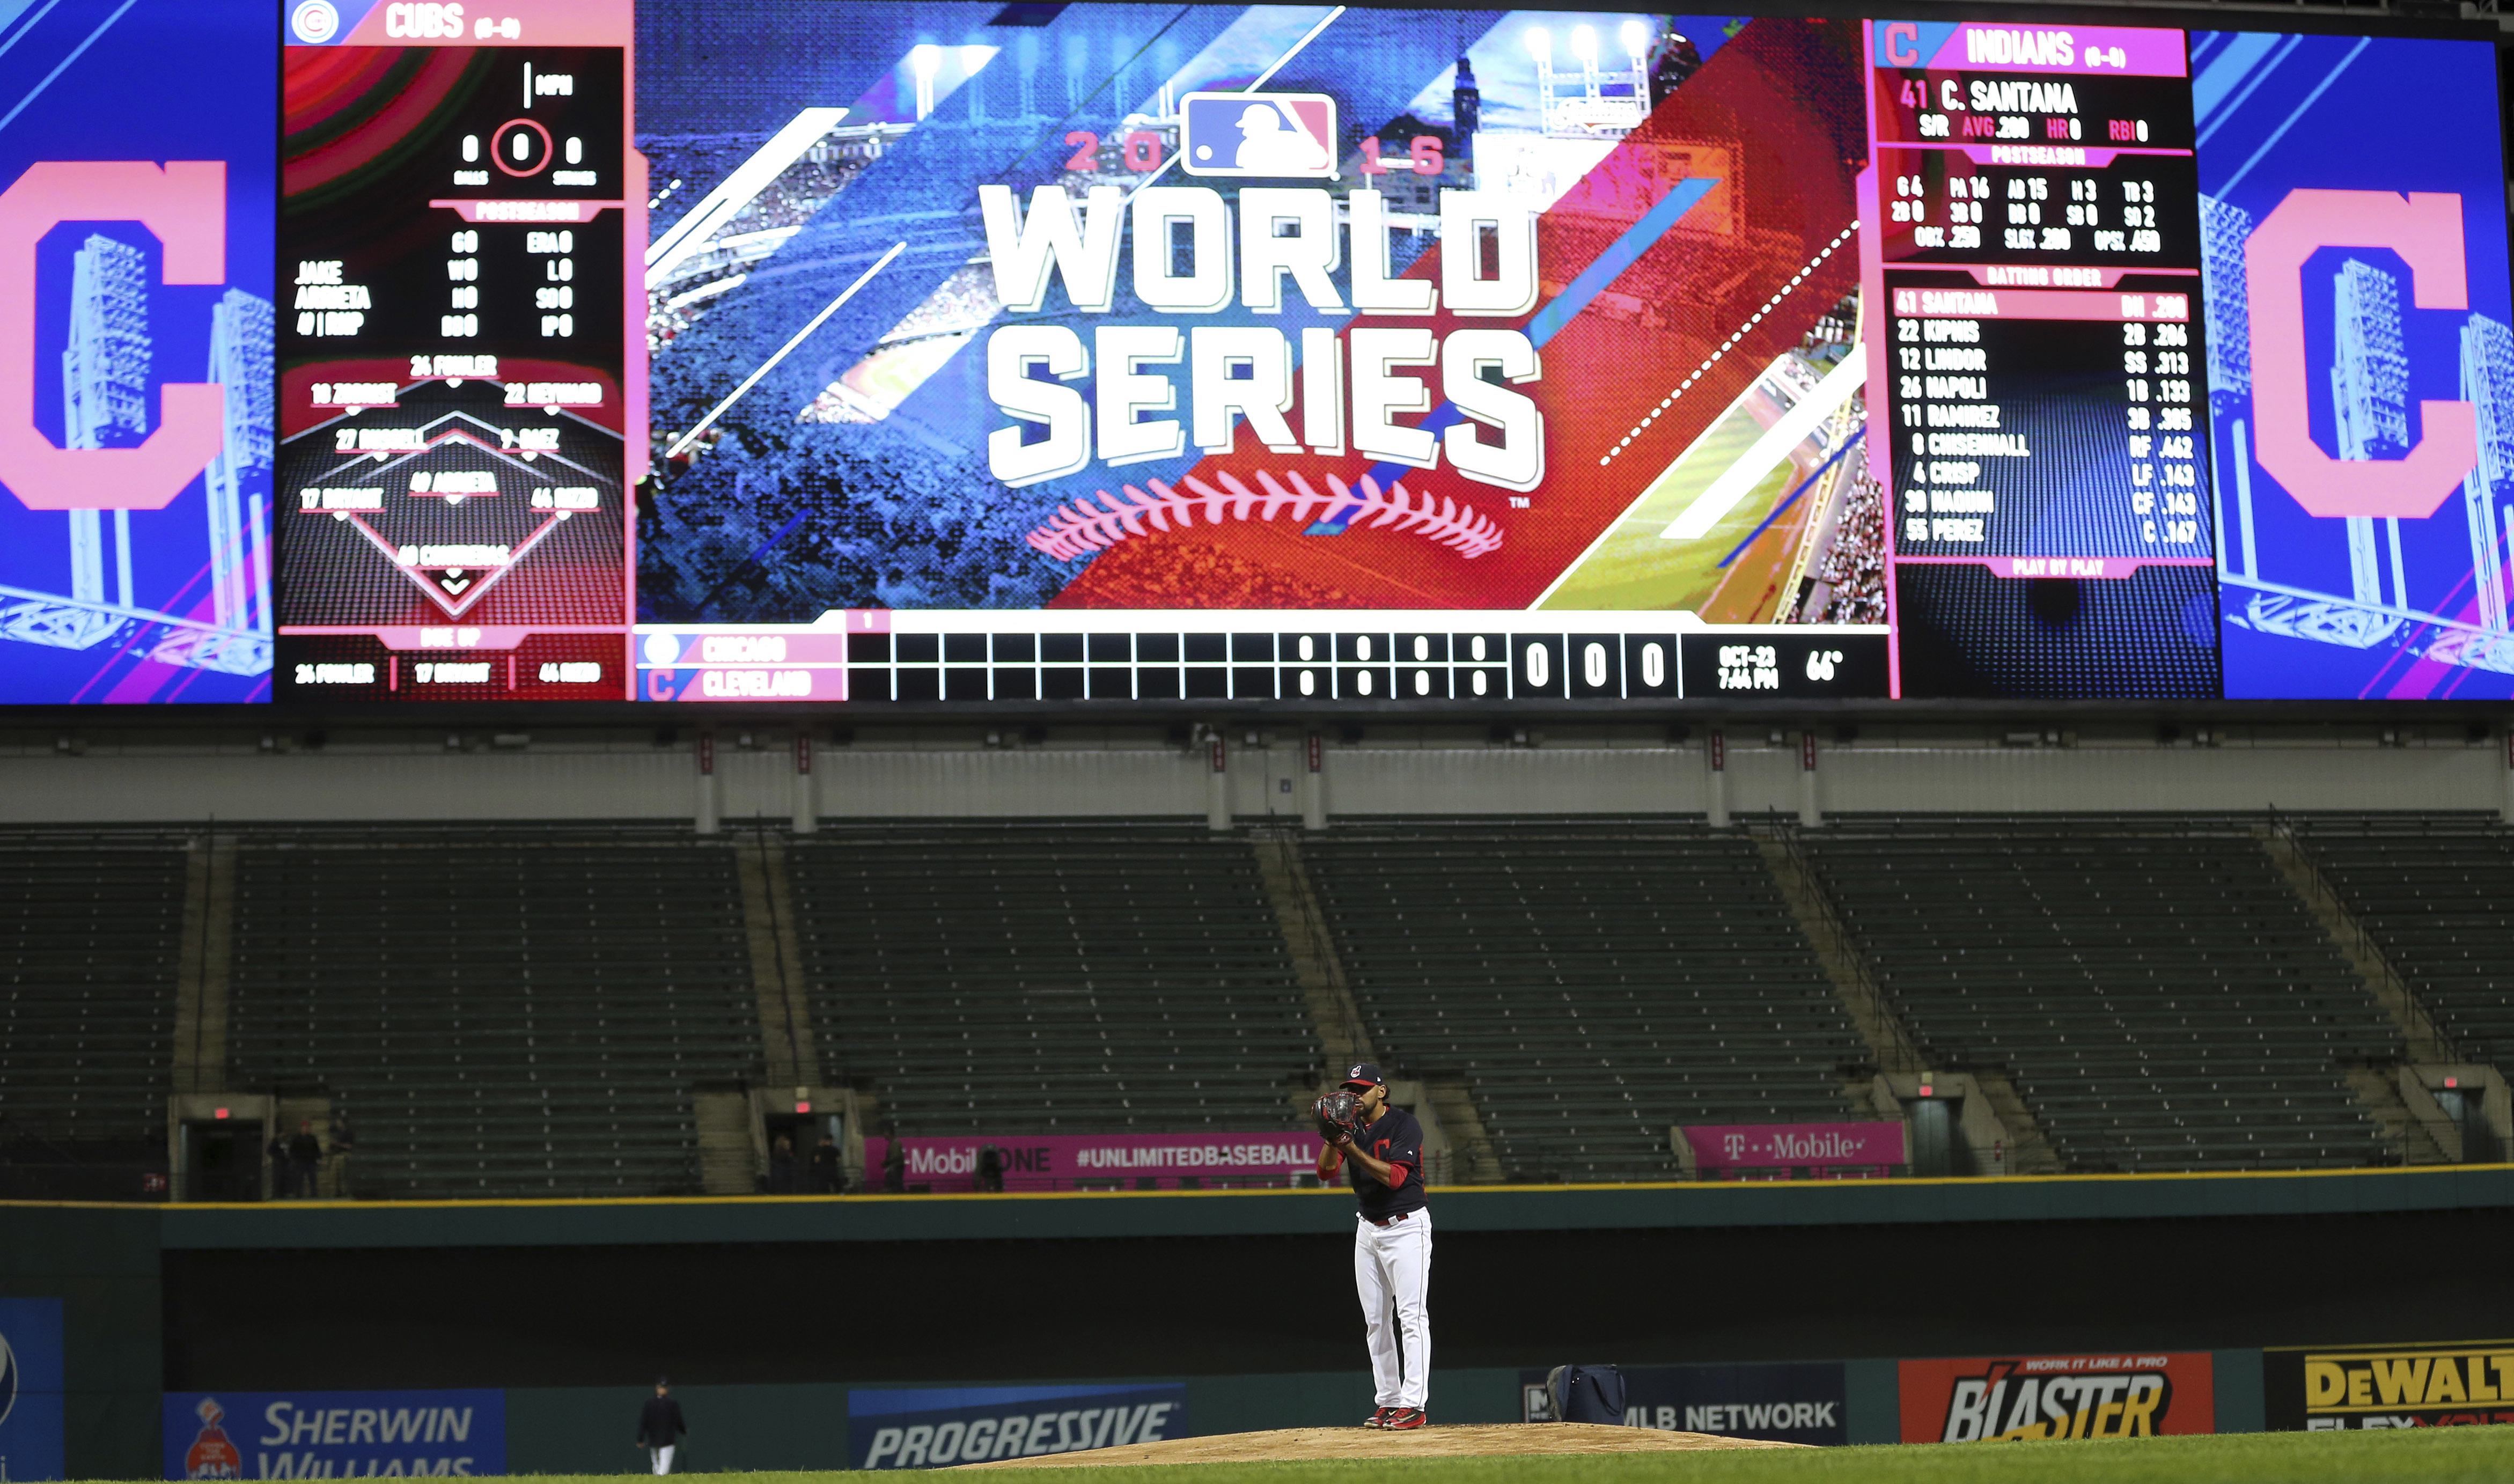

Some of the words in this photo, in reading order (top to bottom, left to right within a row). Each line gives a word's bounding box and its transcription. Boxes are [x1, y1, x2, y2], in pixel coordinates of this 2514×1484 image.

[386, 3, 464, 38] CUBS
[1885, 22, 1918, 67] C
[1967, 29, 2074, 65] INDIANS
[1900, 80, 1927, 108] 41
[1942, 79, 1965, 111] C.
[1971, 80, 2078, 114] SANTANA
[1962, 116, 1994, 136] AVG
[2047, 119, 2068, 138] HR
[2069, 118, 2082, 140] 0
[2109, 120, 2135, 141] RBI
[2136, 120, 2148, 142] 0
[1064, 130, 1161, 171] 20
[1359, 135, 1444, 174] 16
[1992, 146, 2085, 165] POSTSEASON
[1897, 176, 1909, 197] G
[1910, 175, 1923, 197] 4
[1950, 178, 1968, 198] PA
[1969, 177, 1990, 199] 16
[2008, 179, 2026, 200] AB
[2027, 178, 2048, 200] 15
[2072, 181, 2083, 201] H
[2085, 179, 2097, 201] 3
[2123, 182, 2141, 202] TB
[2142, 181, 2154, 203] 3
[476, 202, 579, 221] POSTSEASON
[1892, 201, 1910, 222] 2B
[1912, 200, 1924, 222] 0
[1970, 201, 1982, 223] 0
[2028, 202, 2040, 225] 0
[2086, 204, 2098, 226] 0
[2144, 205, 2155, 227] 2
[978, 184, 1539, 316] WORLD
[547, 260, 558, 281] L
[1988, 267, 2048, 285] BATTING
[2053, 268, 2101, 286] ORDER
[1896, 291, 1916, 313] 41
[1922, 291, 1998, 314] SANTANA
[0, 161, 226, 510] C
[1898, 319, 1920, 342] 22
[1924, 319, 1980, 343] KIPNIS
[2123, 323, 2146, 346] 2B
[1899, 348, 1921, 370] 12
[1925, 348, 1987, 371] LINDOR
[2125, 351, 2147, 373] SS
[2155, 351, 2189, 374] .313
[2244, 188, 2478, 519] C
[504, 383, 526, 404] 22
[1900, 376, 1922, 398] 26
[1926, 376, 1987, 399] NAPOLI
[2127, 379, 2149, 402] 1B
[2156, 380, 2190, 402] .133
[987, 324, 1545, 493] SERIES
[1902, 404, 1921, 427] 11
[1928, 405, 2000, 428] RAMIREZ
[2128, 407, 2150, 430] 3B
[336, 429, 357, 450] 27
[498, 429, 514, 450] 9
[1928, 433, 2030, 457] CHISENHALL
[2129, 435, 2151, 458] RF
[1913, 461, 1926, 484] 4
[1930, 461, 1980, 484] CRISP
[2132, 464, 2153, 487] LF
[2160, 464, 2195, 487] .143
[300, 488, 320, 509] 17
[1931, 490, 1994, 513] NAQUIN
[2132, 491, 2155, 515] CF
[2162, 492, 2196, 516] .143
[1906, 518, 1928, 541] 55
[1932, 518, 1984, 542] PEREZ
[2143, 520, 2156, 543] C
[2163, 520, 2197, 543] .167
[2013, 559, 2046, 575] PLAY
[2050, 559, 2067, 575] BY
[2071, 559, 2104, 576] PLAY
[1527, 643, 1548, 687] 0
[1585, 643, 1606, 687] 0
[1642, 643, 1664, 687] 0
[1719, 646, 1776, 667] OCT-23
[703, 671, 811, 696] CLEVELAND
[1754, 668, 1778, 689] PM
[1077, 1144, 1315, 1167] #UNLIMITEDBASEBALL
[2026, 1361, 2068, 1371] WORK
[2072, 1360, 2085, 1370] IT
[2089, 1358, 2119, 1369] LIKE
[2122, 1358, 2133, 1368] A
[2136, 1357, 2167, 1368] PRO
[1686, 1403, 1836, 1431] NETWORK
[1942, 1373, 2164, 1443] BLASTER
[261, 1401, 473, 1445] SHERWIN
[863, 1402, 1172, 1469] PROGRESSIVE
